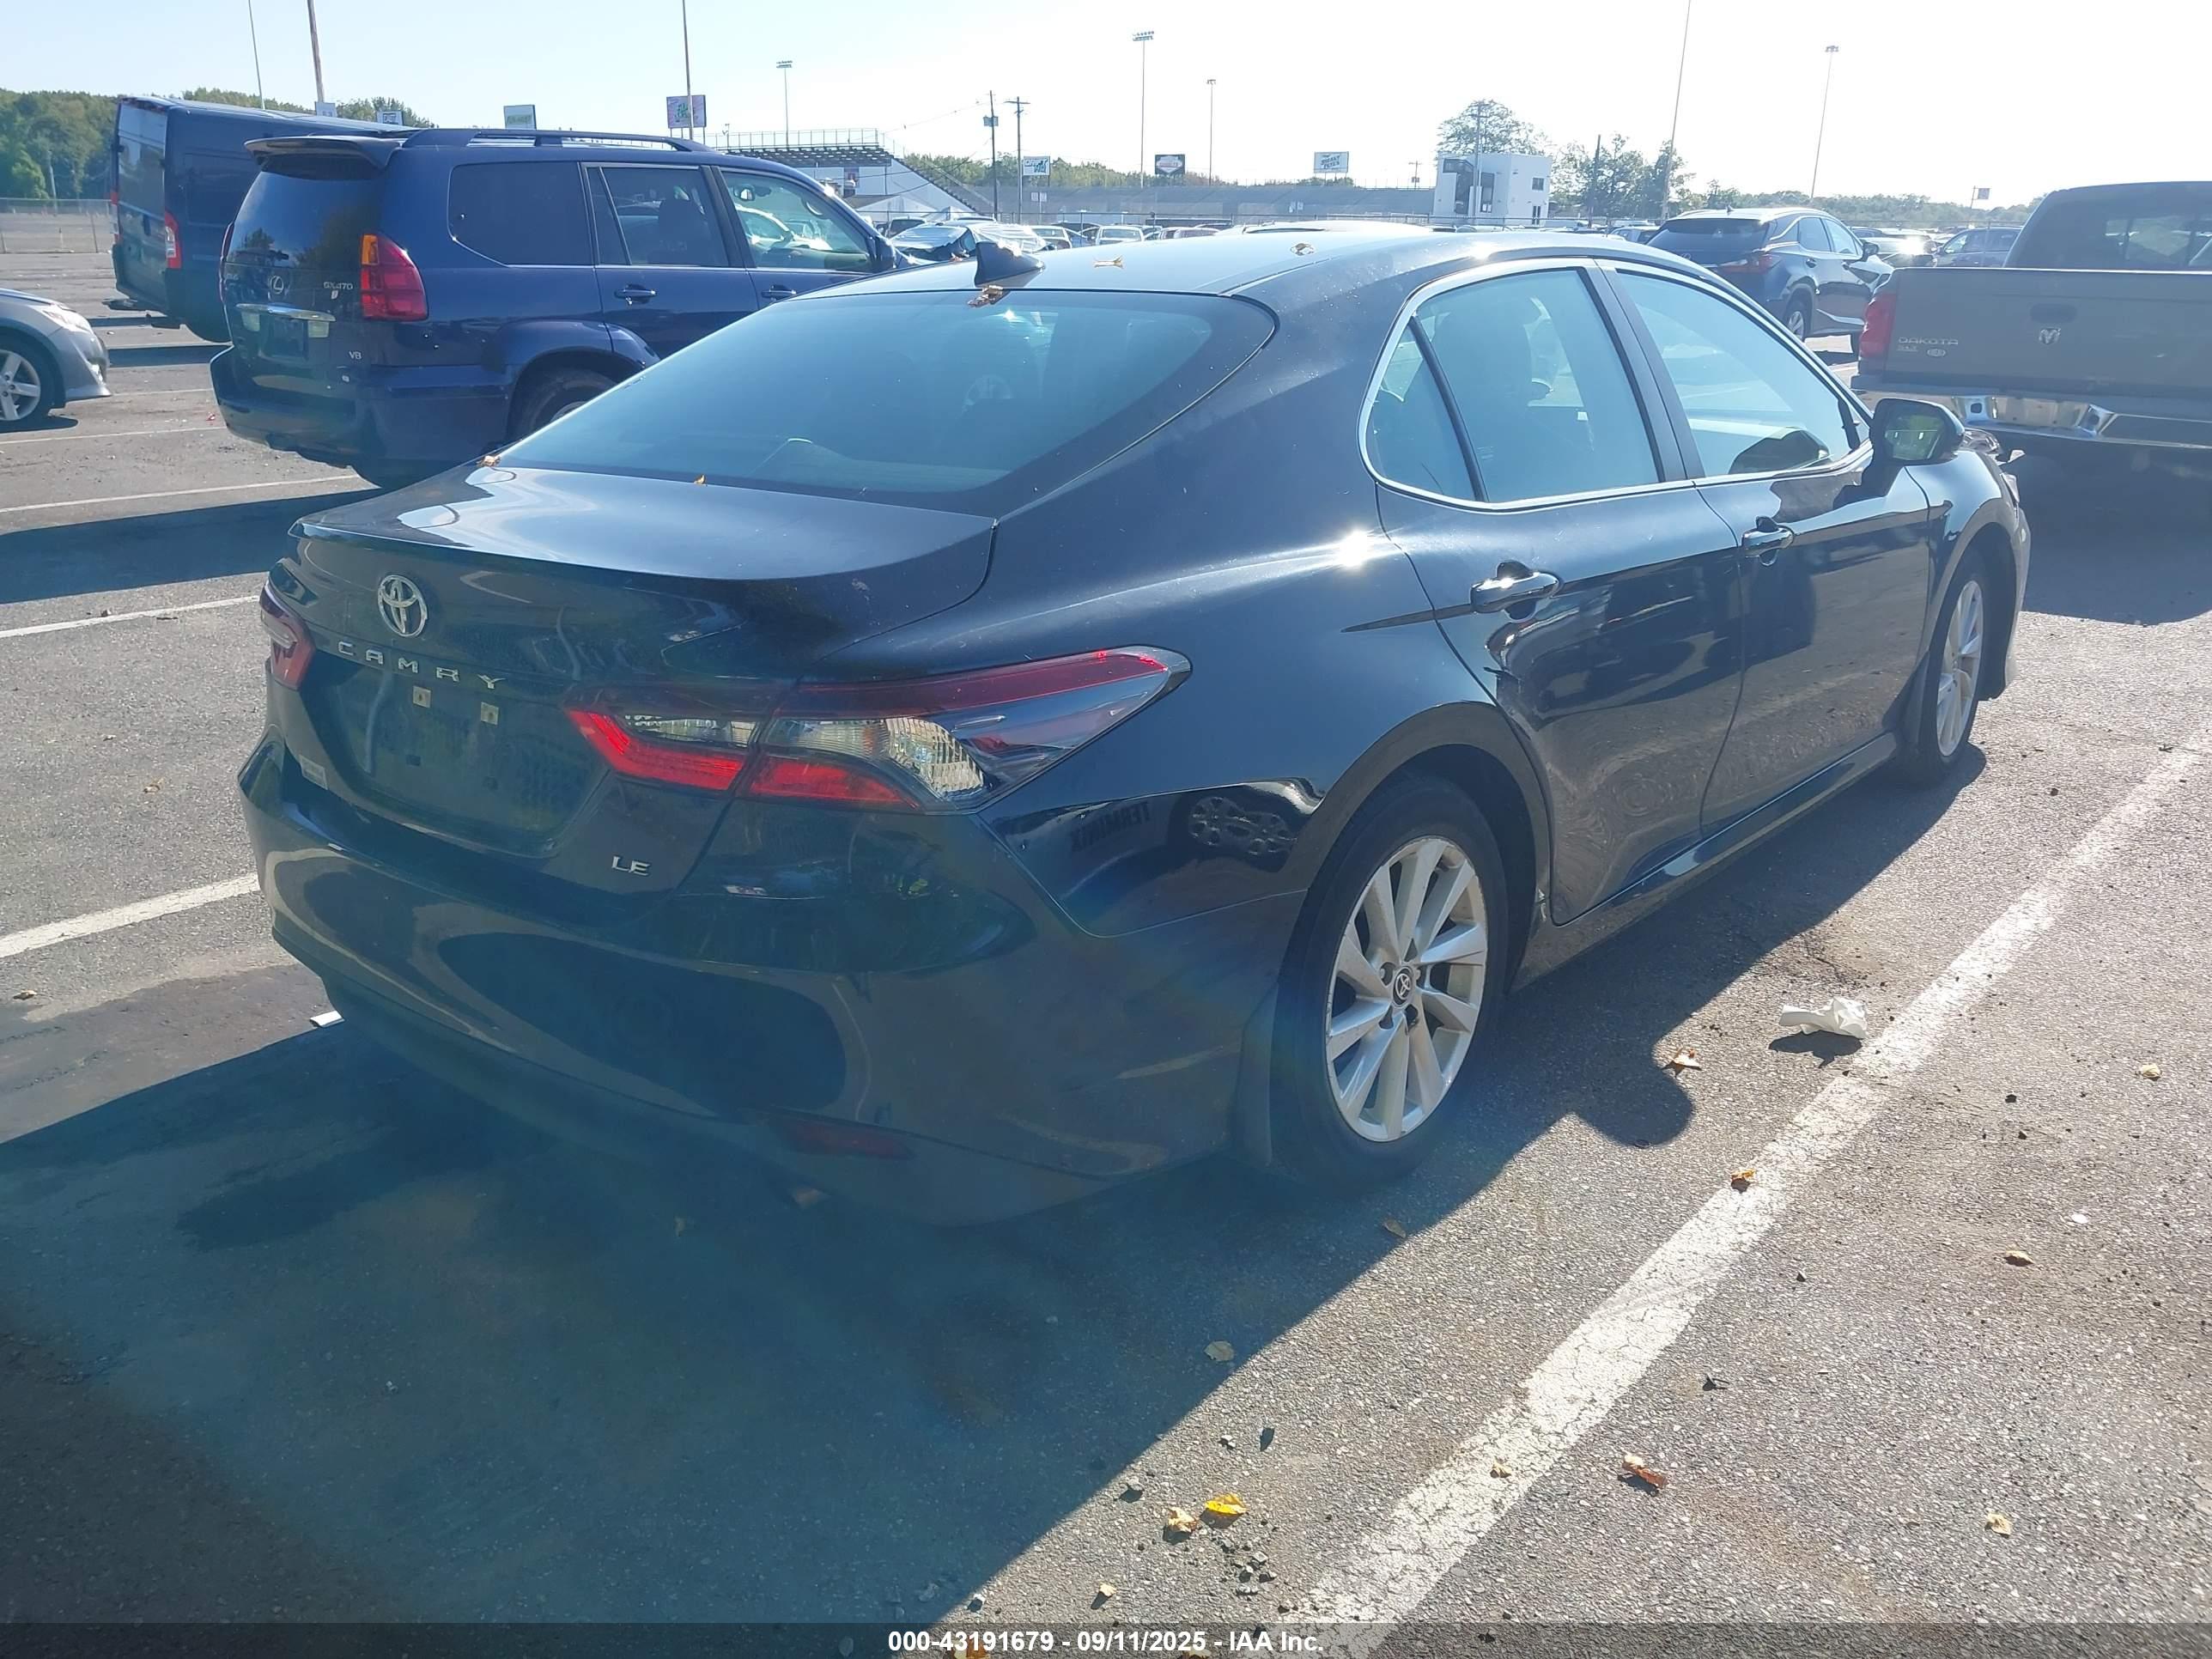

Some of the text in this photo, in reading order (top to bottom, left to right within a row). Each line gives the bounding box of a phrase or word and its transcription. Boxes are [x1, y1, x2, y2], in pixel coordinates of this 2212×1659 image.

[349, 350, 362, 360] V8
[337, 641, 507, 690] CAMRY
[611, 854, 651, 877] LE
